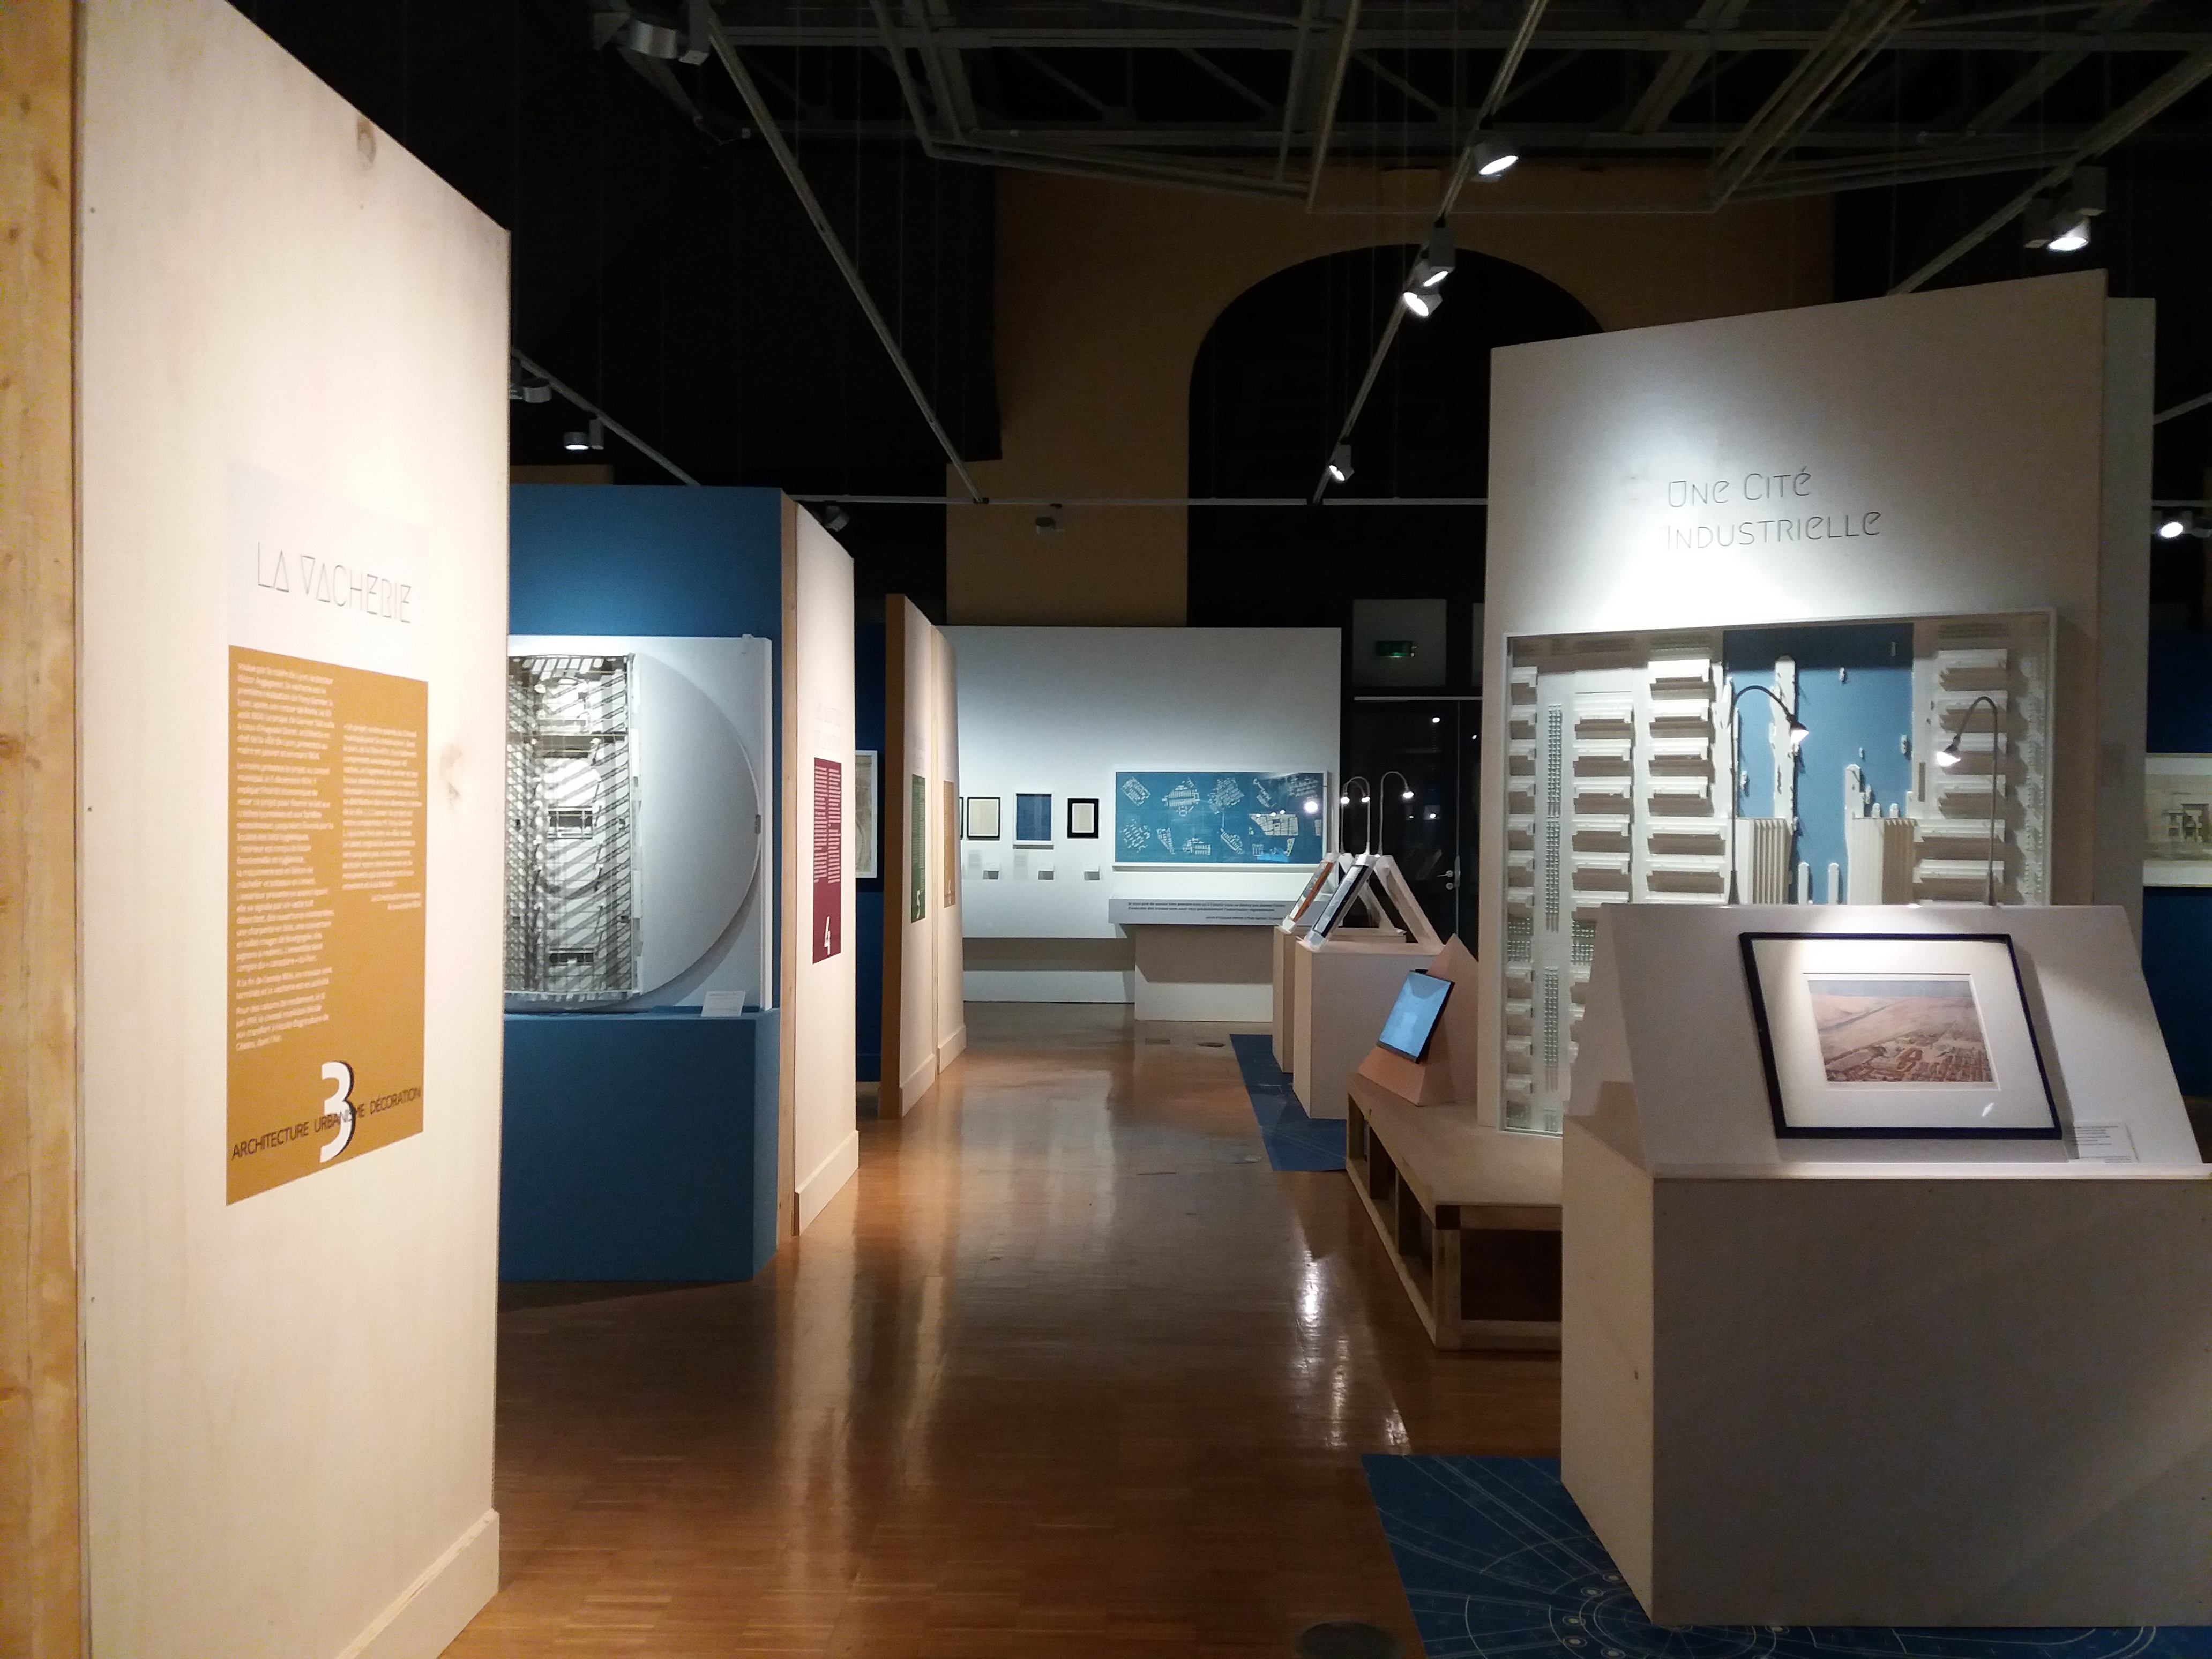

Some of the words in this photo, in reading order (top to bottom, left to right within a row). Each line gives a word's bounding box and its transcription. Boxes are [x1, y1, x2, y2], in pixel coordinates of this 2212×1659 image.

[257, 541, 290, 593] LA
[300, 554, 412, 624] VACHERIE
[824, 916, 831, 955] 4
[231, 1121, 309, 1161] ARCHITECTURE
[370, 1085, 421, 1115] DÉCORATION
[319, 1060, 356, 1163] 3
